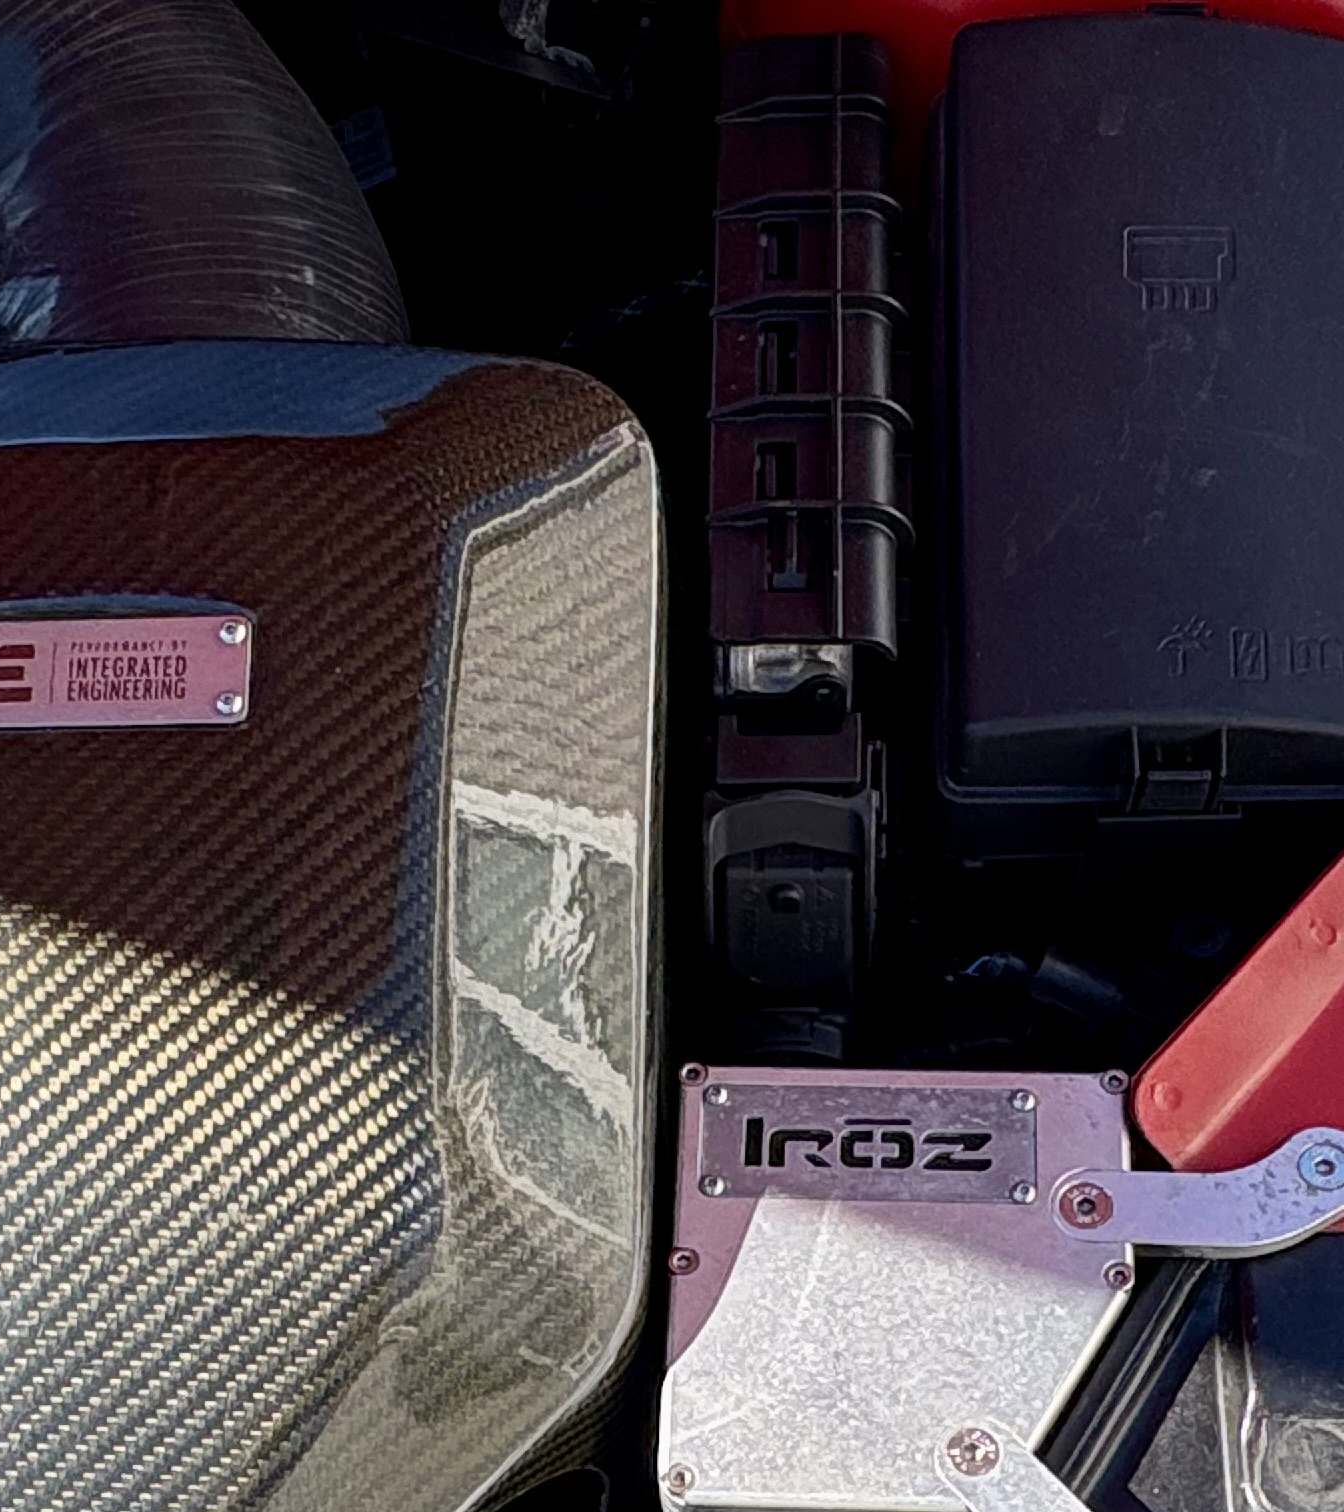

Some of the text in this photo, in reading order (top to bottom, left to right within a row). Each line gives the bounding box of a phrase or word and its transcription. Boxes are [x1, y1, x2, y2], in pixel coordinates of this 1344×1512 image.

[171, 639, 187, 651] BY
[68, 655, 187, 679] INTEGRATED
[67, 678, 186, 702] ENGINEERING
